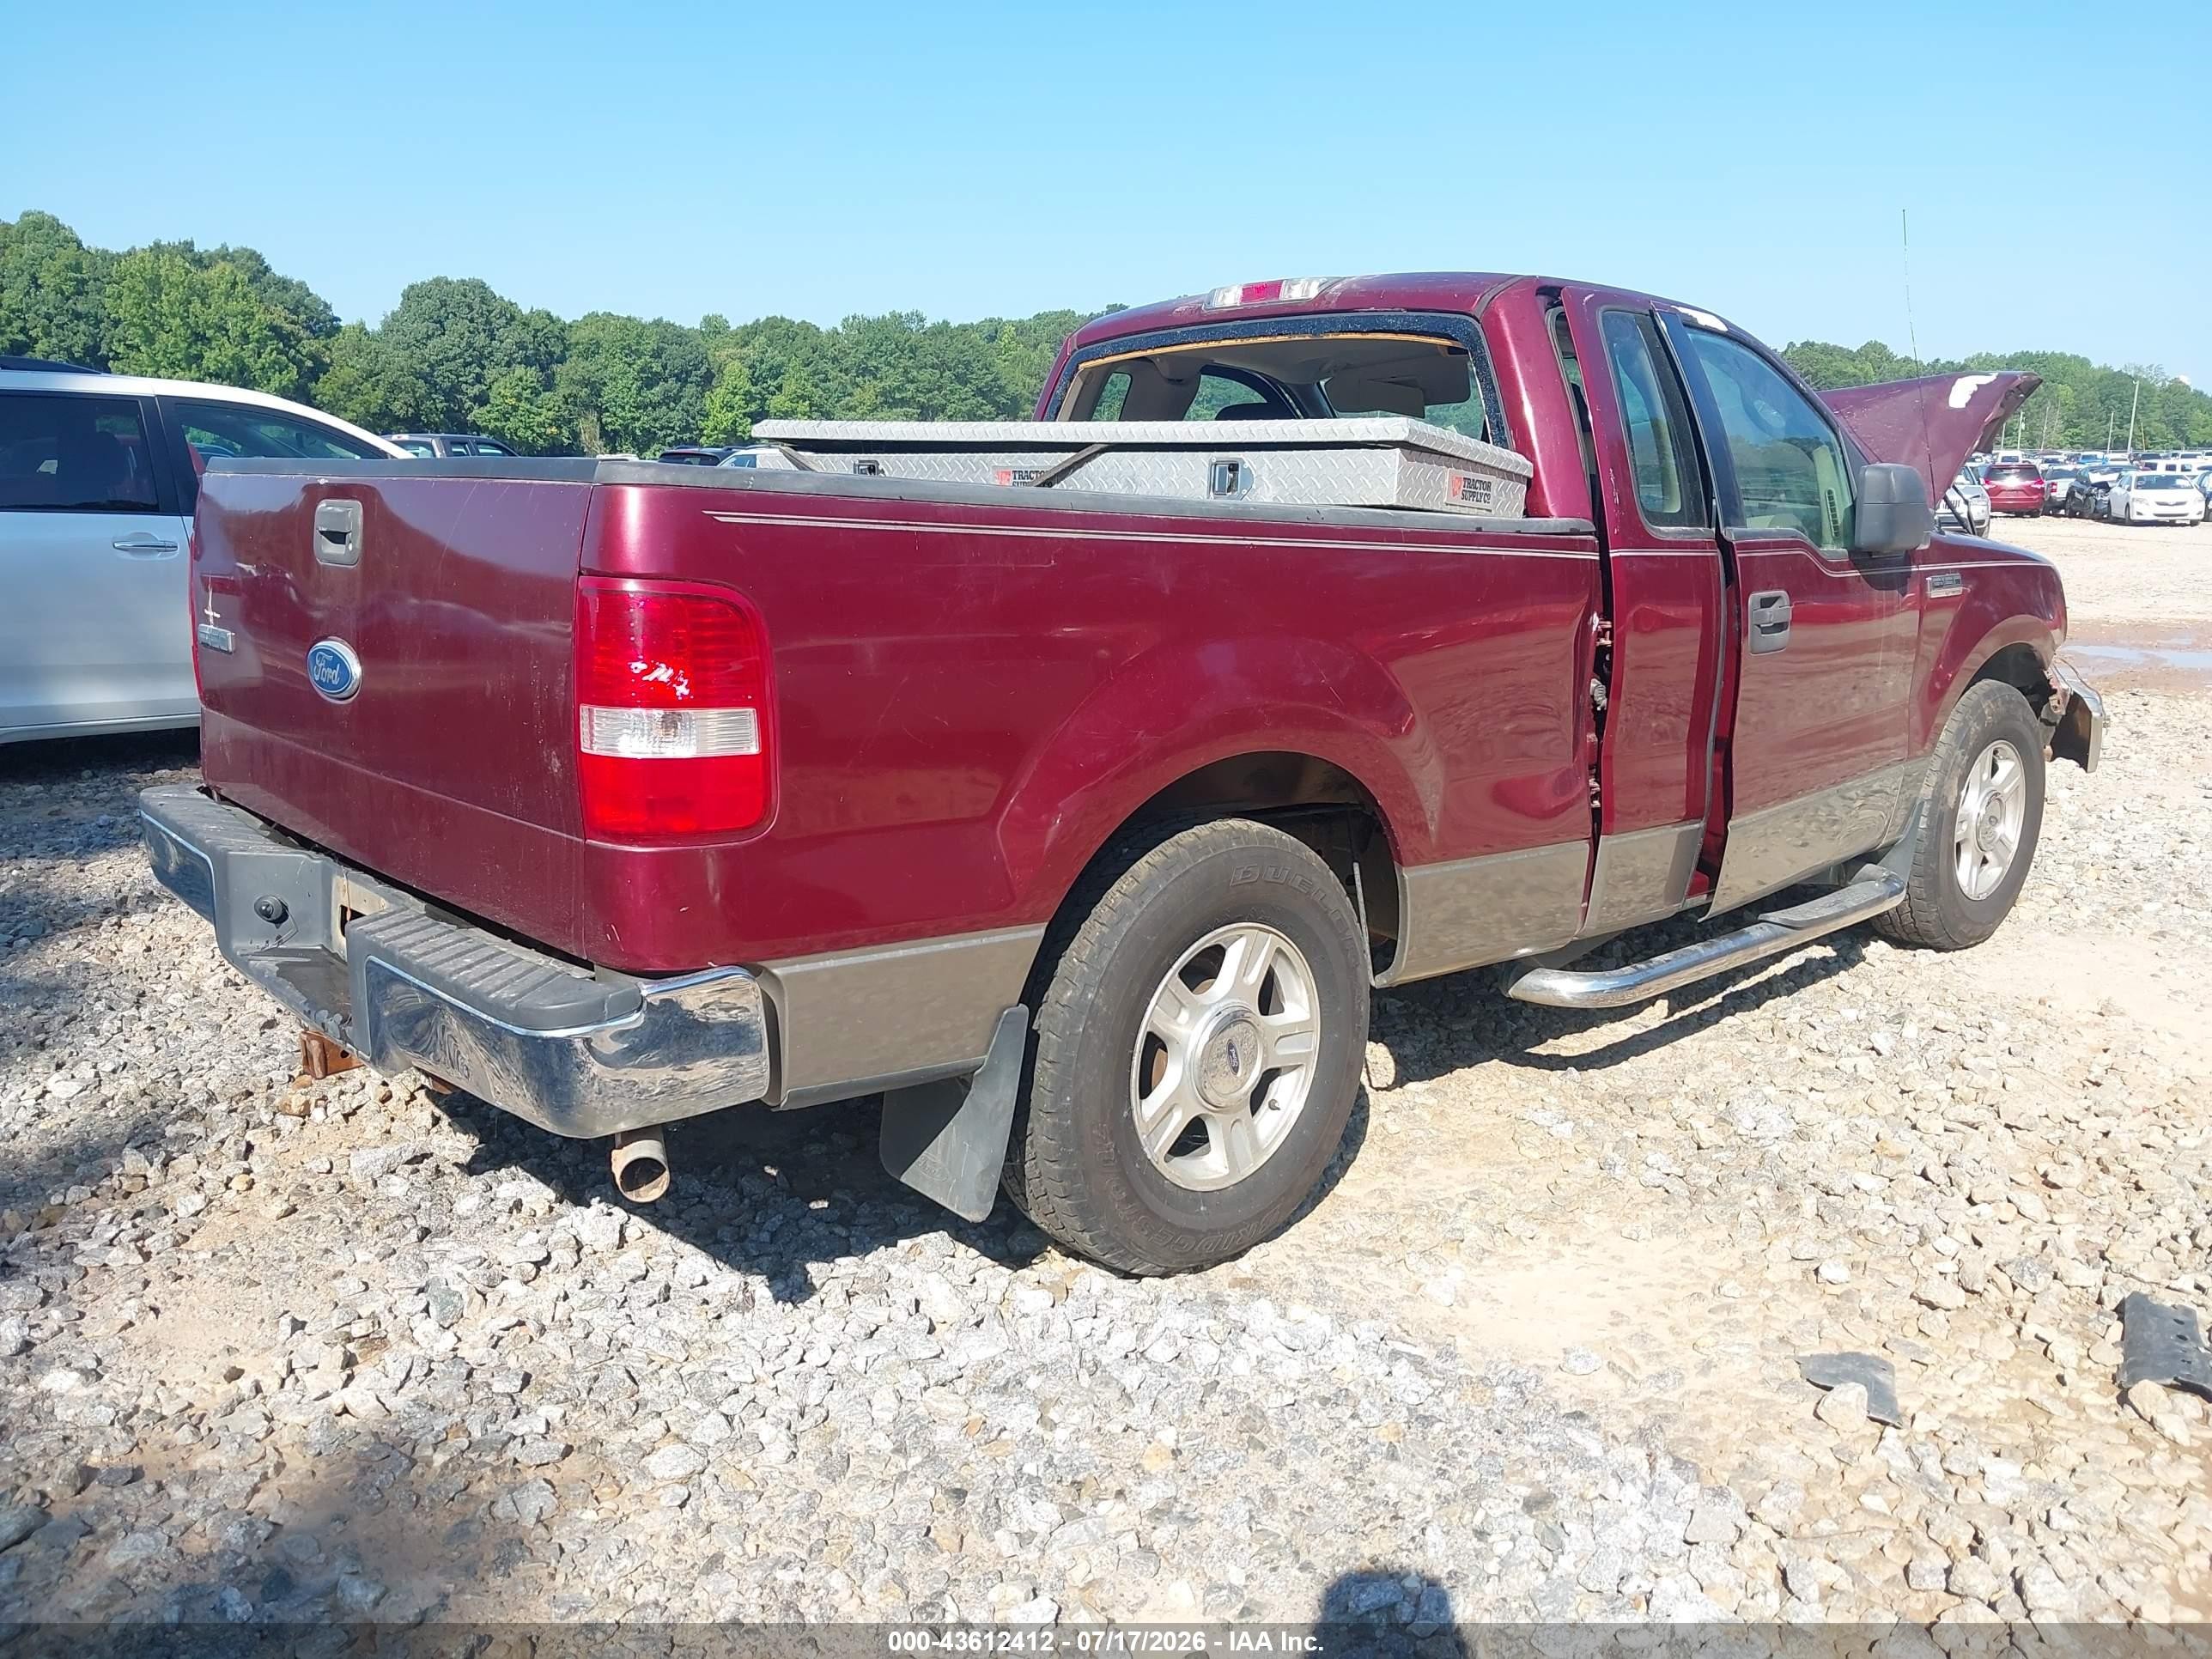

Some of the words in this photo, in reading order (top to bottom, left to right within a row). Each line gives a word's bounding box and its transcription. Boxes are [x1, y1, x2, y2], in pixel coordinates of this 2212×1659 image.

[1012, 470, 1050, 481] TRACTO
[1462, 477, 1492, 492] TRACTOR
[1461, 489, 1484, 503] SUPPLY
[313, 651, 340, 685] Ford
